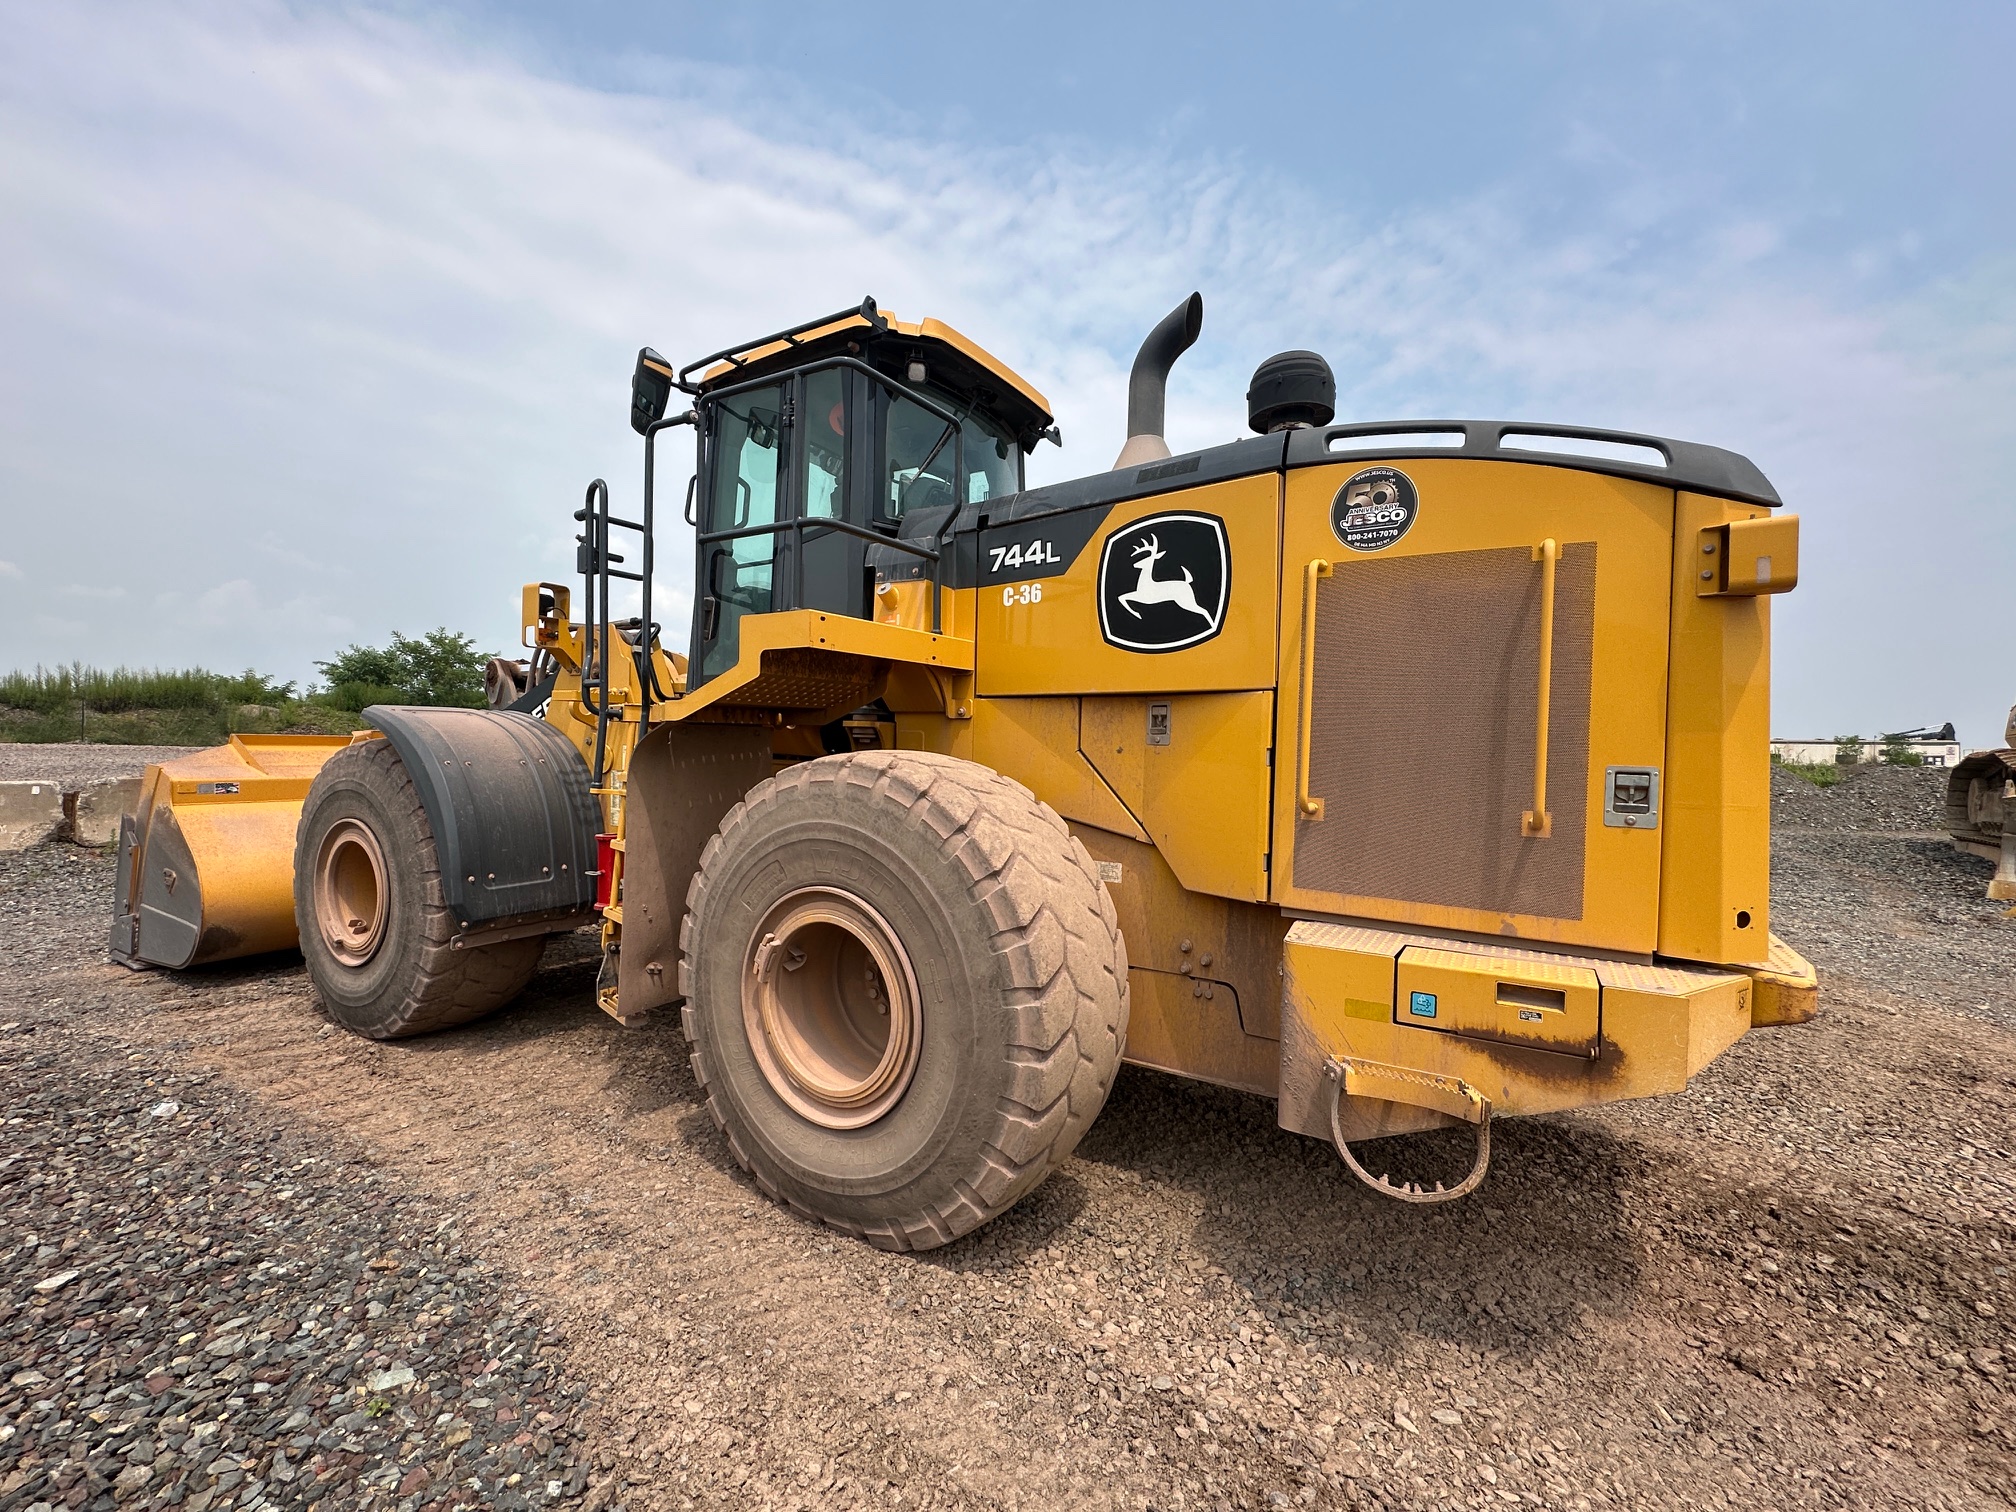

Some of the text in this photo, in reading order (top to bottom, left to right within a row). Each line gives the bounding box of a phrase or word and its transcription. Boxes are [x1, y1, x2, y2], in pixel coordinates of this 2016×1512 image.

[1342, 509, 1405, 528] JESCO
[1349, 503, 1399, 515] ANNIVERSARY
[1347, 530, 1398, 541] 800-241-7070
[989, 539, 1061, 572] 744L
[1002, 583, 1042, 607] C-36
